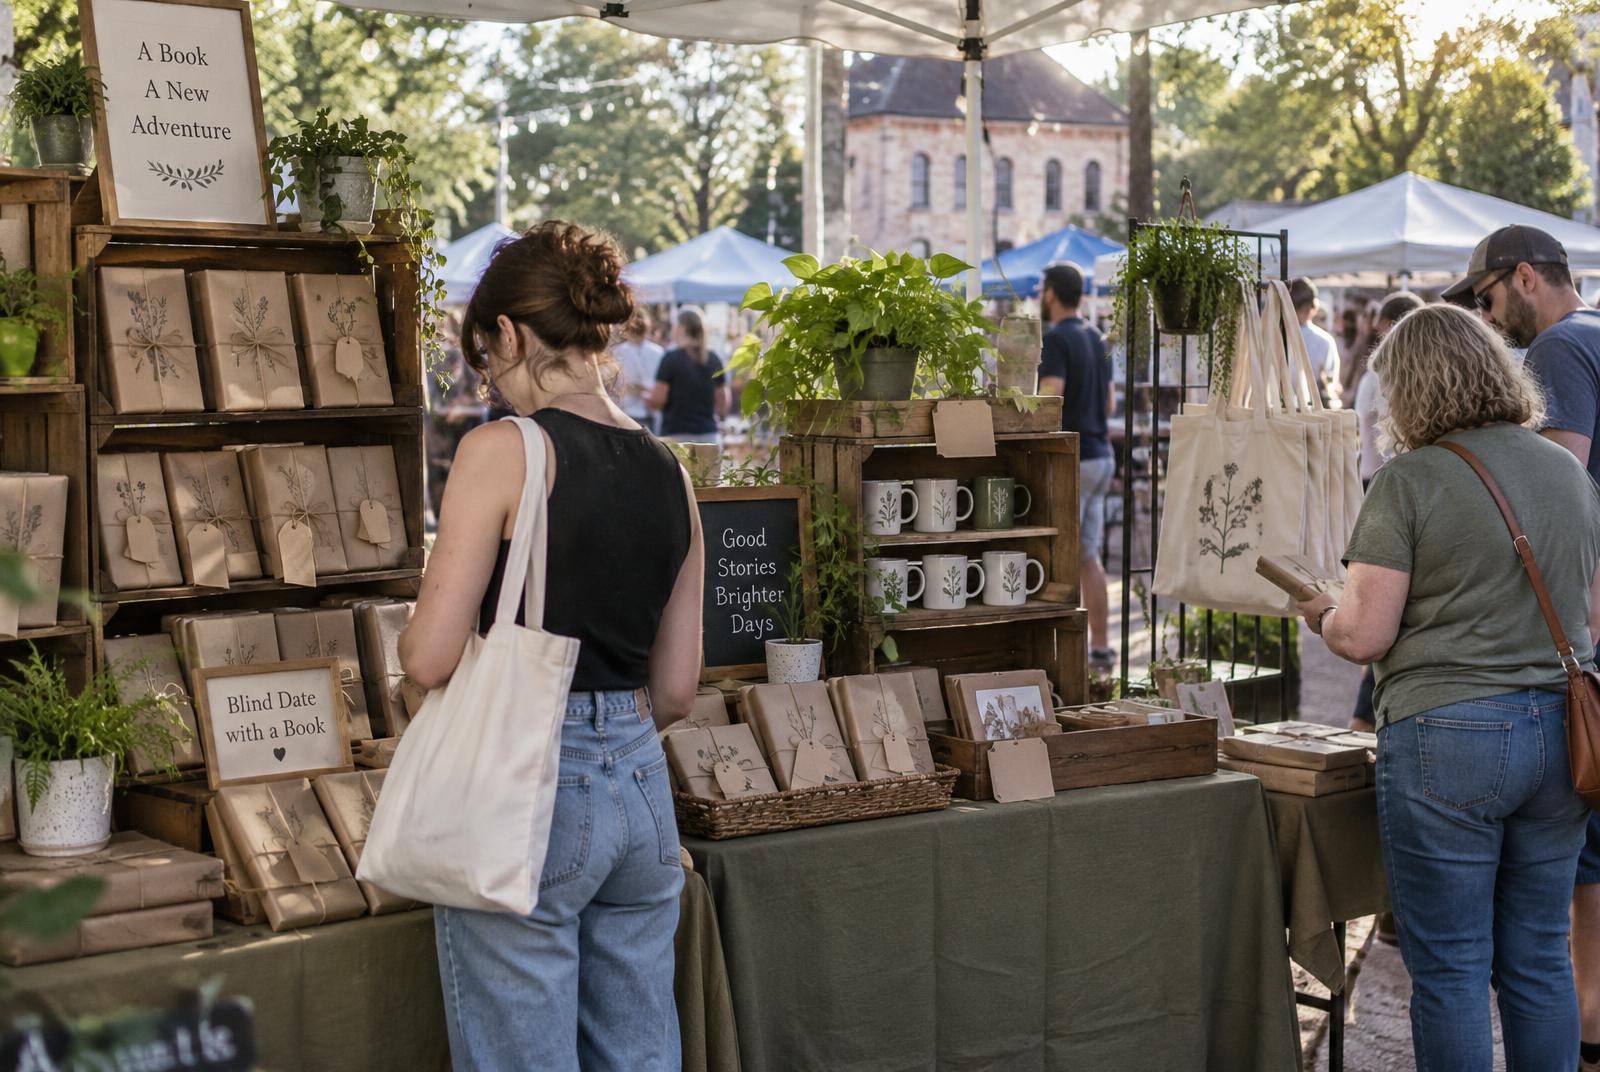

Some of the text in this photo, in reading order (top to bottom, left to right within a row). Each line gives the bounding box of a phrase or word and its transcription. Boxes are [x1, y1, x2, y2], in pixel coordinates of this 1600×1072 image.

[137, 41, 209, 66] A Book
[144, 79, 209, 102] A New
[131, 115, 232, 140] Adventure
[722, 527, 767, 548] Good
[718, 558, 776, 577] Stories
[715, 585, 784, 611] Brighter
[731, 614, 774, 639] Days
[227, 691, 317, 714] Blind Date
[226, 716, 326, 743] with a Book
